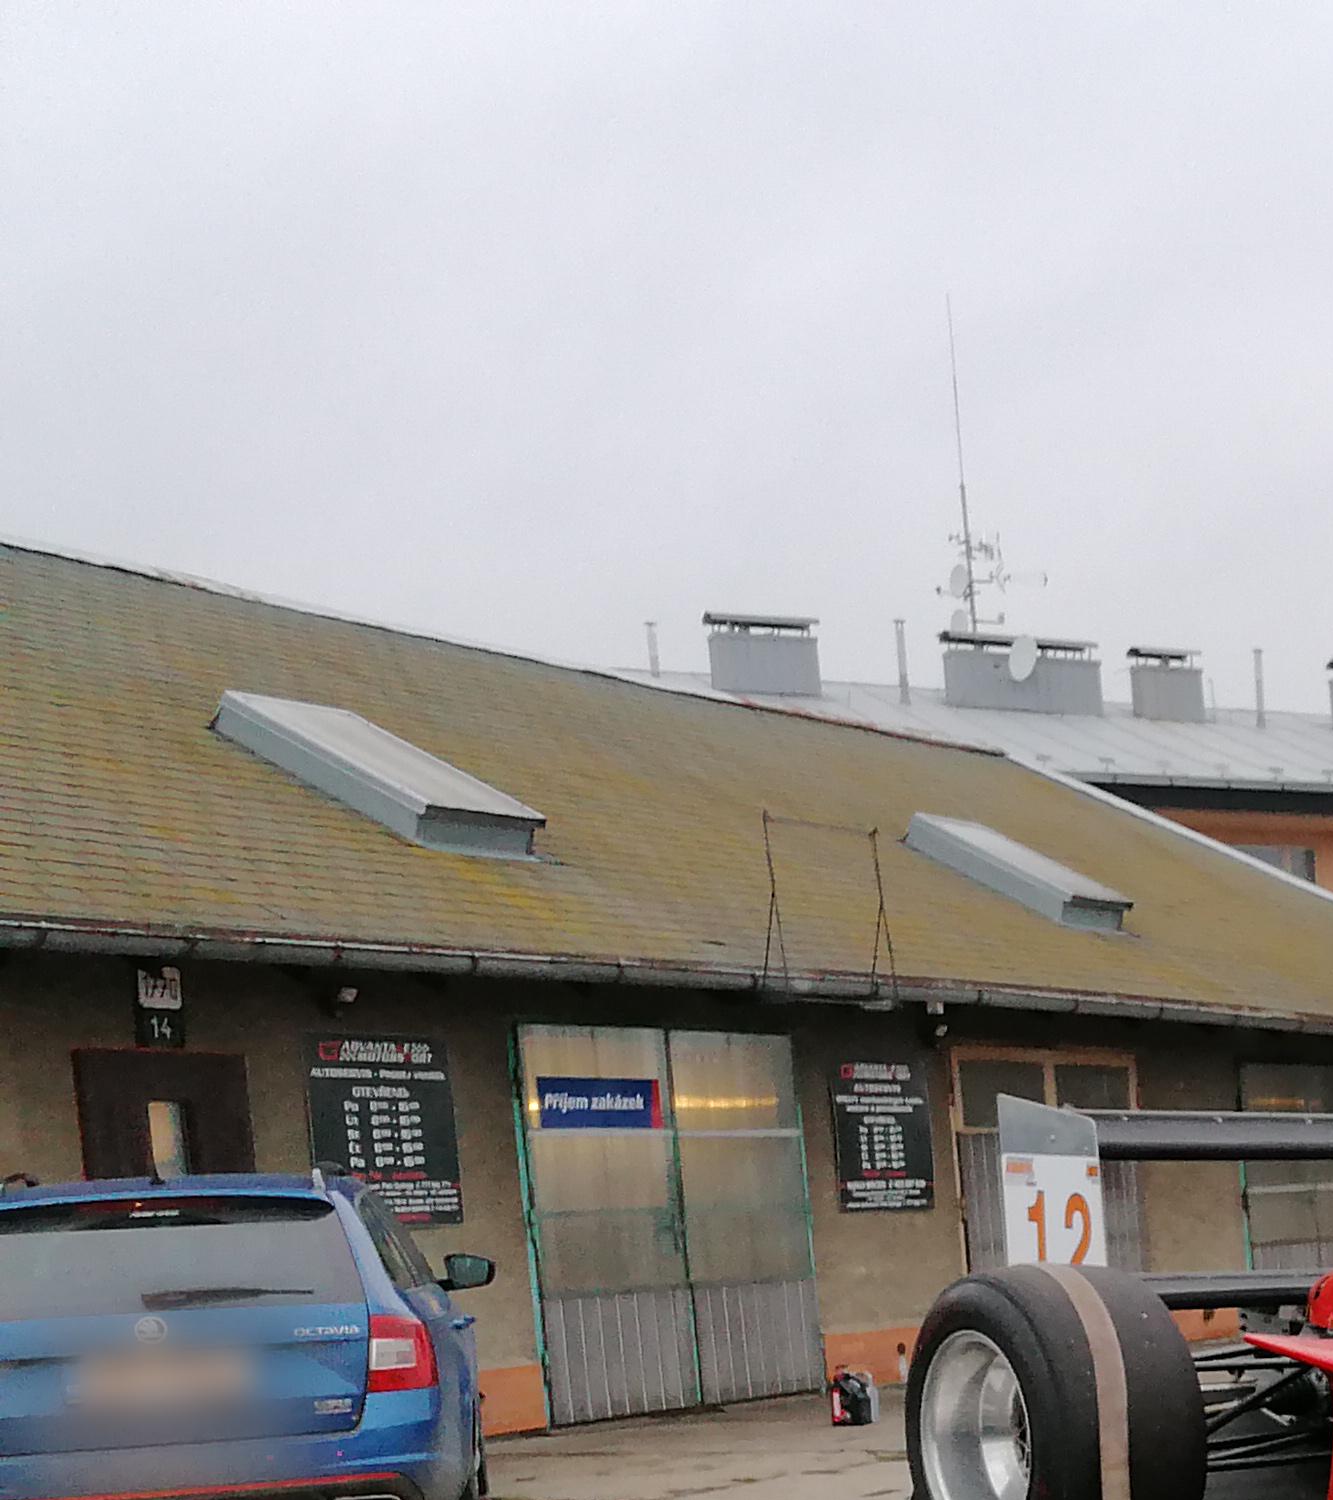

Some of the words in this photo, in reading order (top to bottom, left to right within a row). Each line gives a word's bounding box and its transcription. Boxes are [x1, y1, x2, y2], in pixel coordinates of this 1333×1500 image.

[150, 1014, 172, 1040] 14
[591, 1092, 645, 1110] zakázek
[293, 1324, 360, 1336] OCTAVIA
